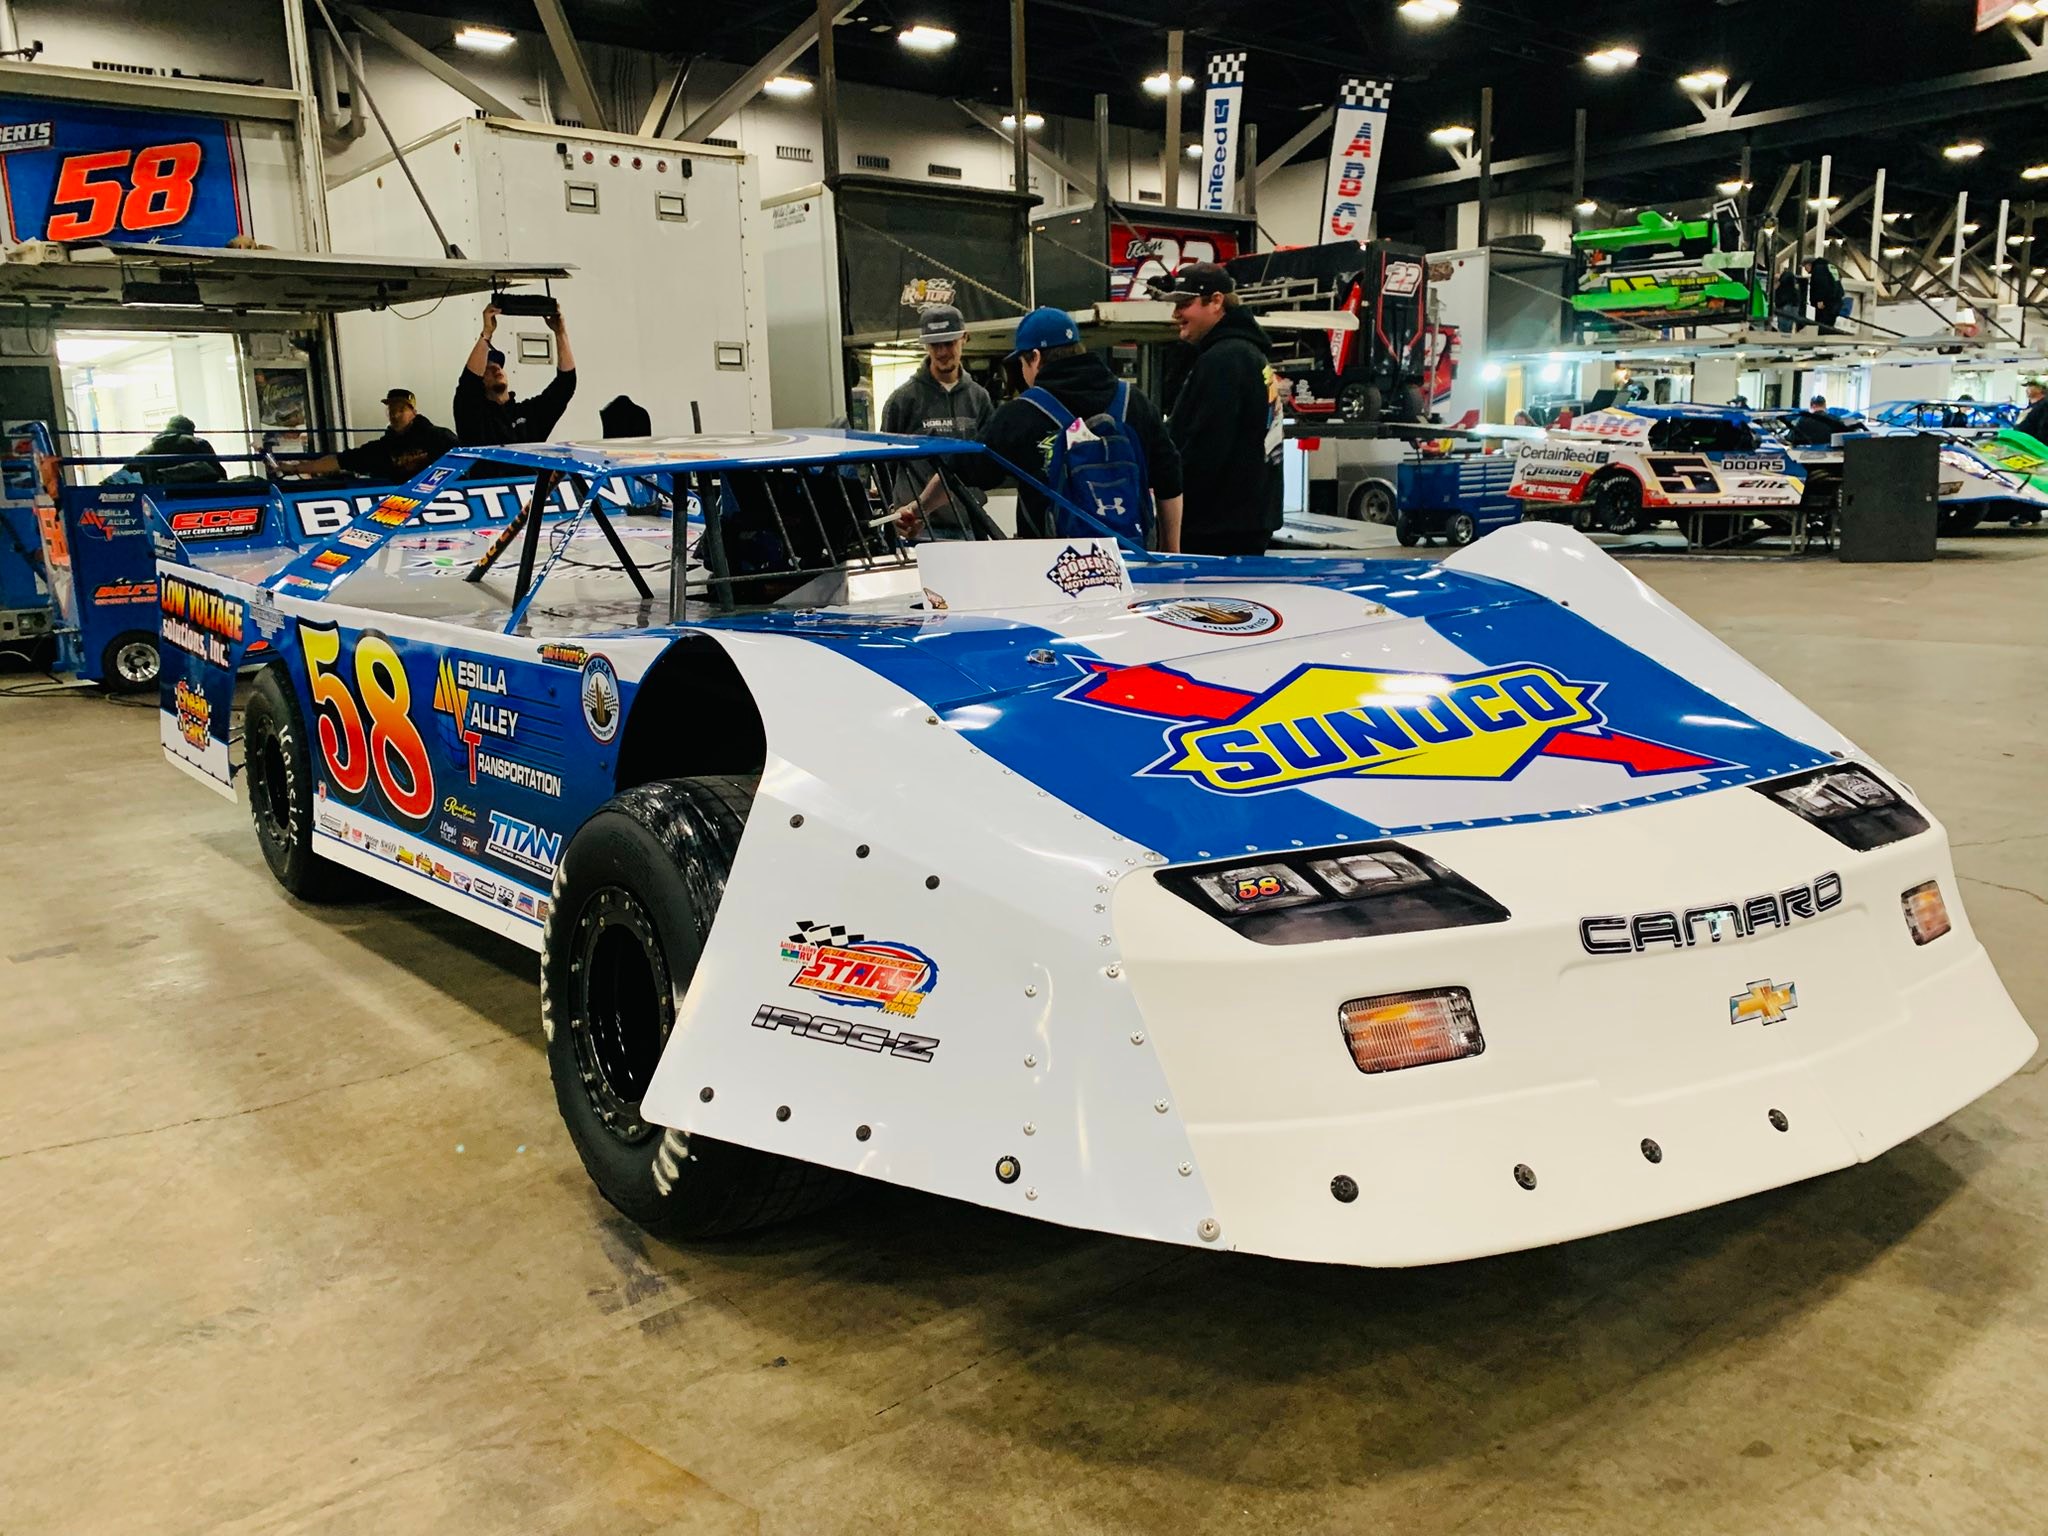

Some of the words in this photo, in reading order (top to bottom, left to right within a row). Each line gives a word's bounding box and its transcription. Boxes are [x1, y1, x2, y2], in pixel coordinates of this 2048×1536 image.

[0, 122, 51, 143] ERTS
[47, 141, 202, 242] 58
[1331, 122, 1373, 236] ABC
[1384, 263, 1422, 295] 22
[1576, 414, 1648, 437] ABC
[1520, 445, 1596, 464] CertainTeed
[1723, 460, 1784, 471] DOORS
[1646, 457, 1722, 494] 5
[172, 509, 259, 530] ECS
[297, 476, 631, 536] BSTEIN
[1058, 555, 1119, 579] ROBERTS
[1064, 576, 1122, 591] MOTORSPORTS
[161, 576, 187, 621] LOW
[188, 587, 243, 643] VOLTAGE
[209, 633, 230, 667] inc.
[298, 622, 436, 821] 58
[1195, 673, 1578, 784] SUNOCO
[463, 730, 562, 798] TRANSPORTATION
[489, 810, 562, 866] TITAN
[1237, 876, 1284, 901] 58
[1579, 870, 1844, 956] CAMARO
[800, 951, 812, 962] RV
[801, 956, 917, 994] STARS
[751, 1003, 941, 1063] IROC-Z
